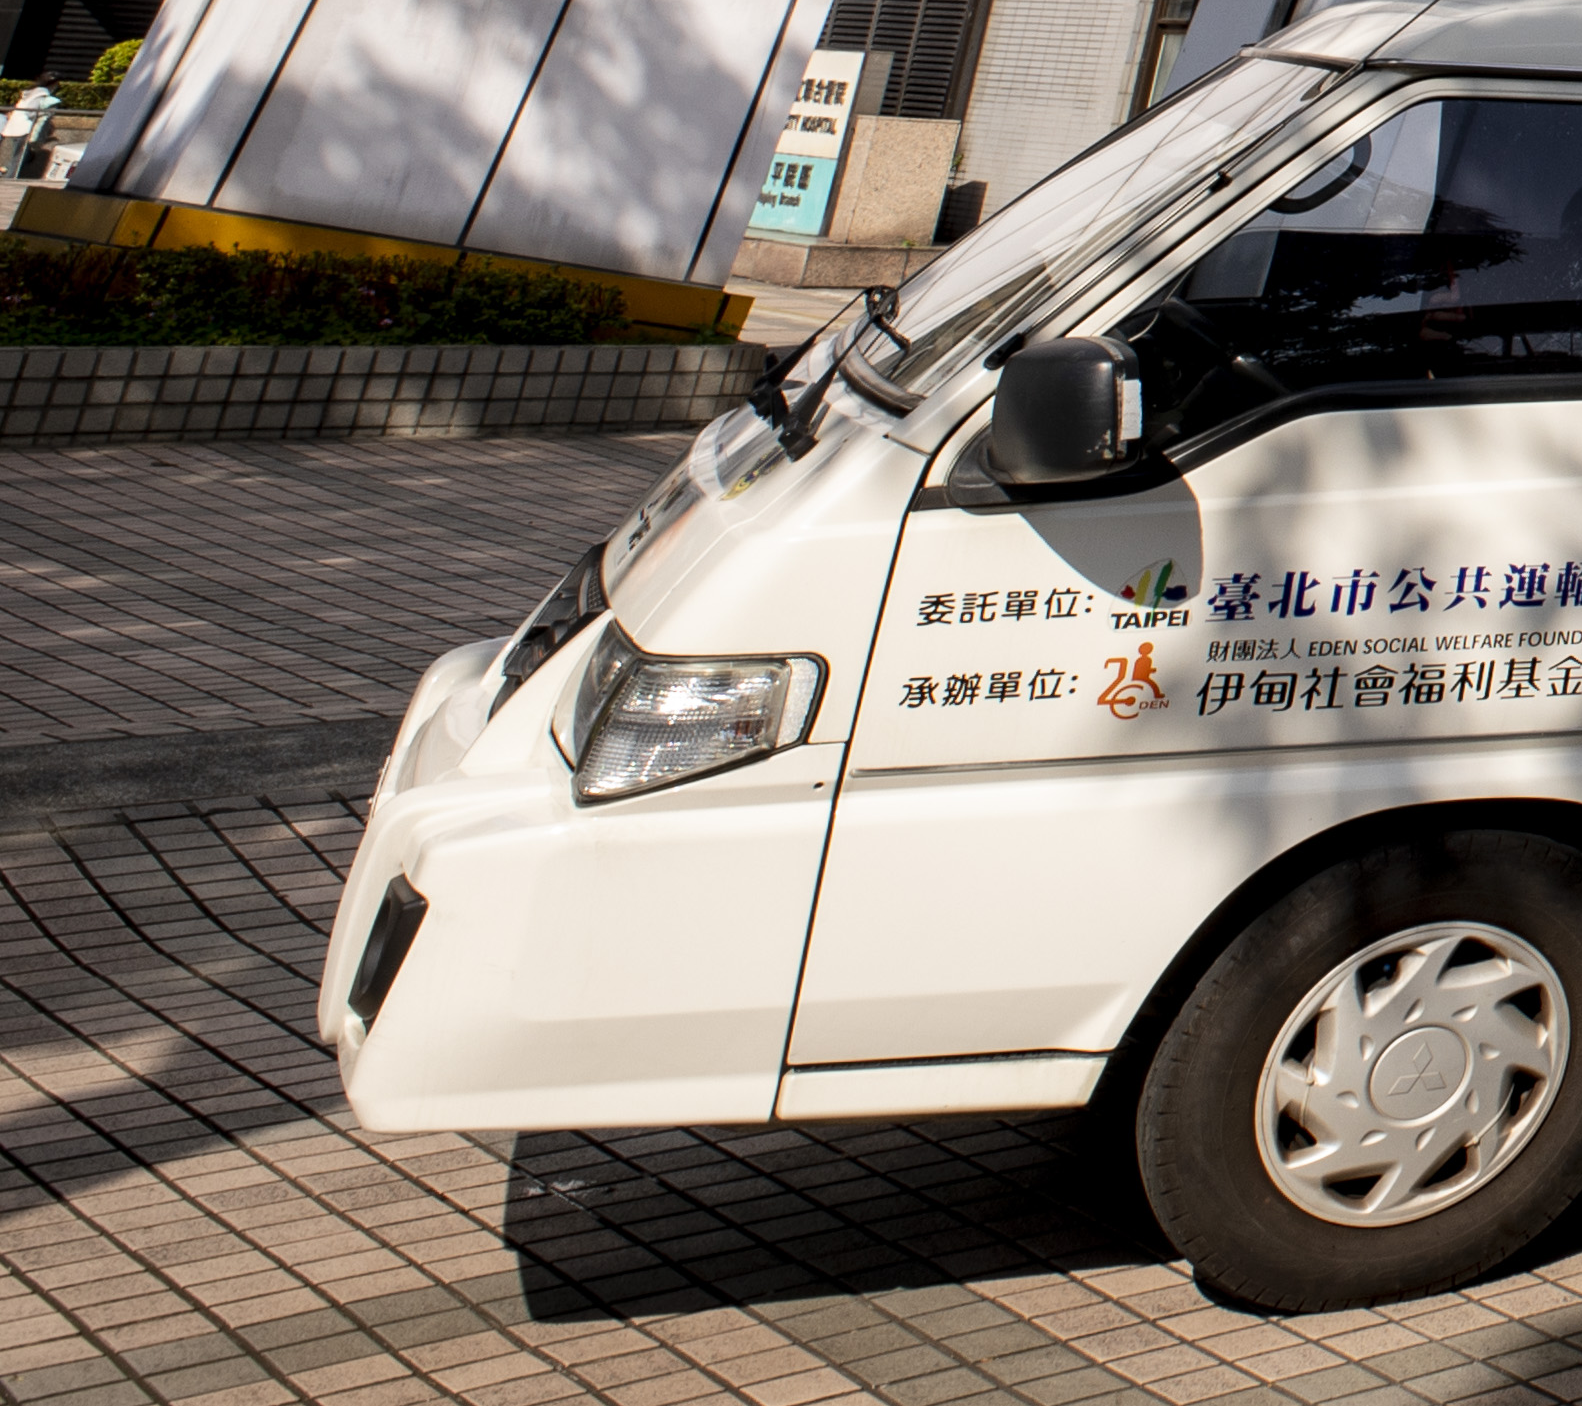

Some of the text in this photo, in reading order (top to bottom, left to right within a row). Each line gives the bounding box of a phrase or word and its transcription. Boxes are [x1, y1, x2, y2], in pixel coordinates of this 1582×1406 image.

[916, 587, 1095, 626] 委託單位:
[1110, 609, 1190, 630] TAIPEI
[1206, 638, 1302, 663] 財團法人
[1308, 638, 1361, 658] EDEN
[1363, 635, 1429, 655] SOCIAL
[1435, 632, 1514, 653] WELFARE
[899, 668, 1079, 708] 承辦單位:
